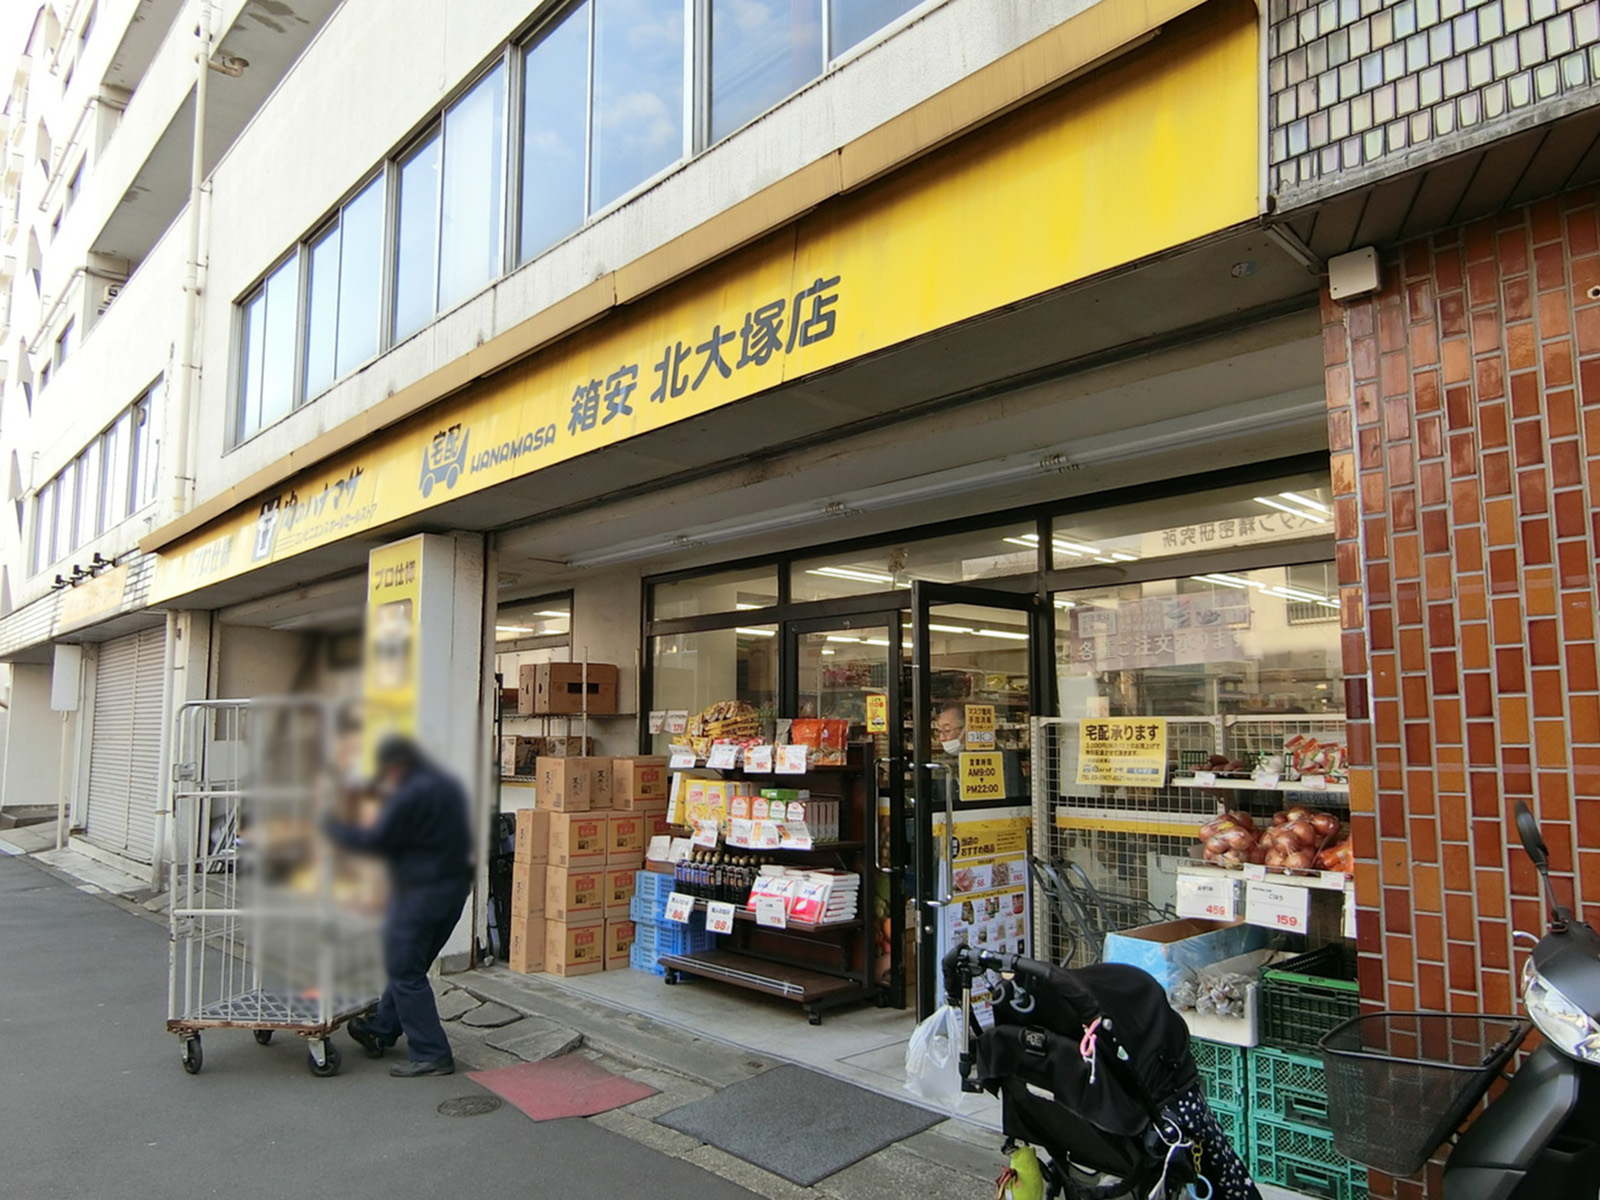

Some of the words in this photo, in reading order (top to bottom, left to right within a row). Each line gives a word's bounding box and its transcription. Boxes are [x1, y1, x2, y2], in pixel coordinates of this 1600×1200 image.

[470, 423, 556, 474] HANAMASA
[568, 364, 638, 437] 箱安
[650, 275, 841, 404] 北大塚店
[431, 423, 462, 465] 宅配
[375, 559, 416, 590] プロ仕様
[1085, 724, 1159, 741] 宅配承ります
[967, 767, 996, 777] AM9:00
[966, 784, 999, 793] PM22:00
[961, 844, 995, 857] おすすめ商品
[1276, 915, 1298, 927] 159
